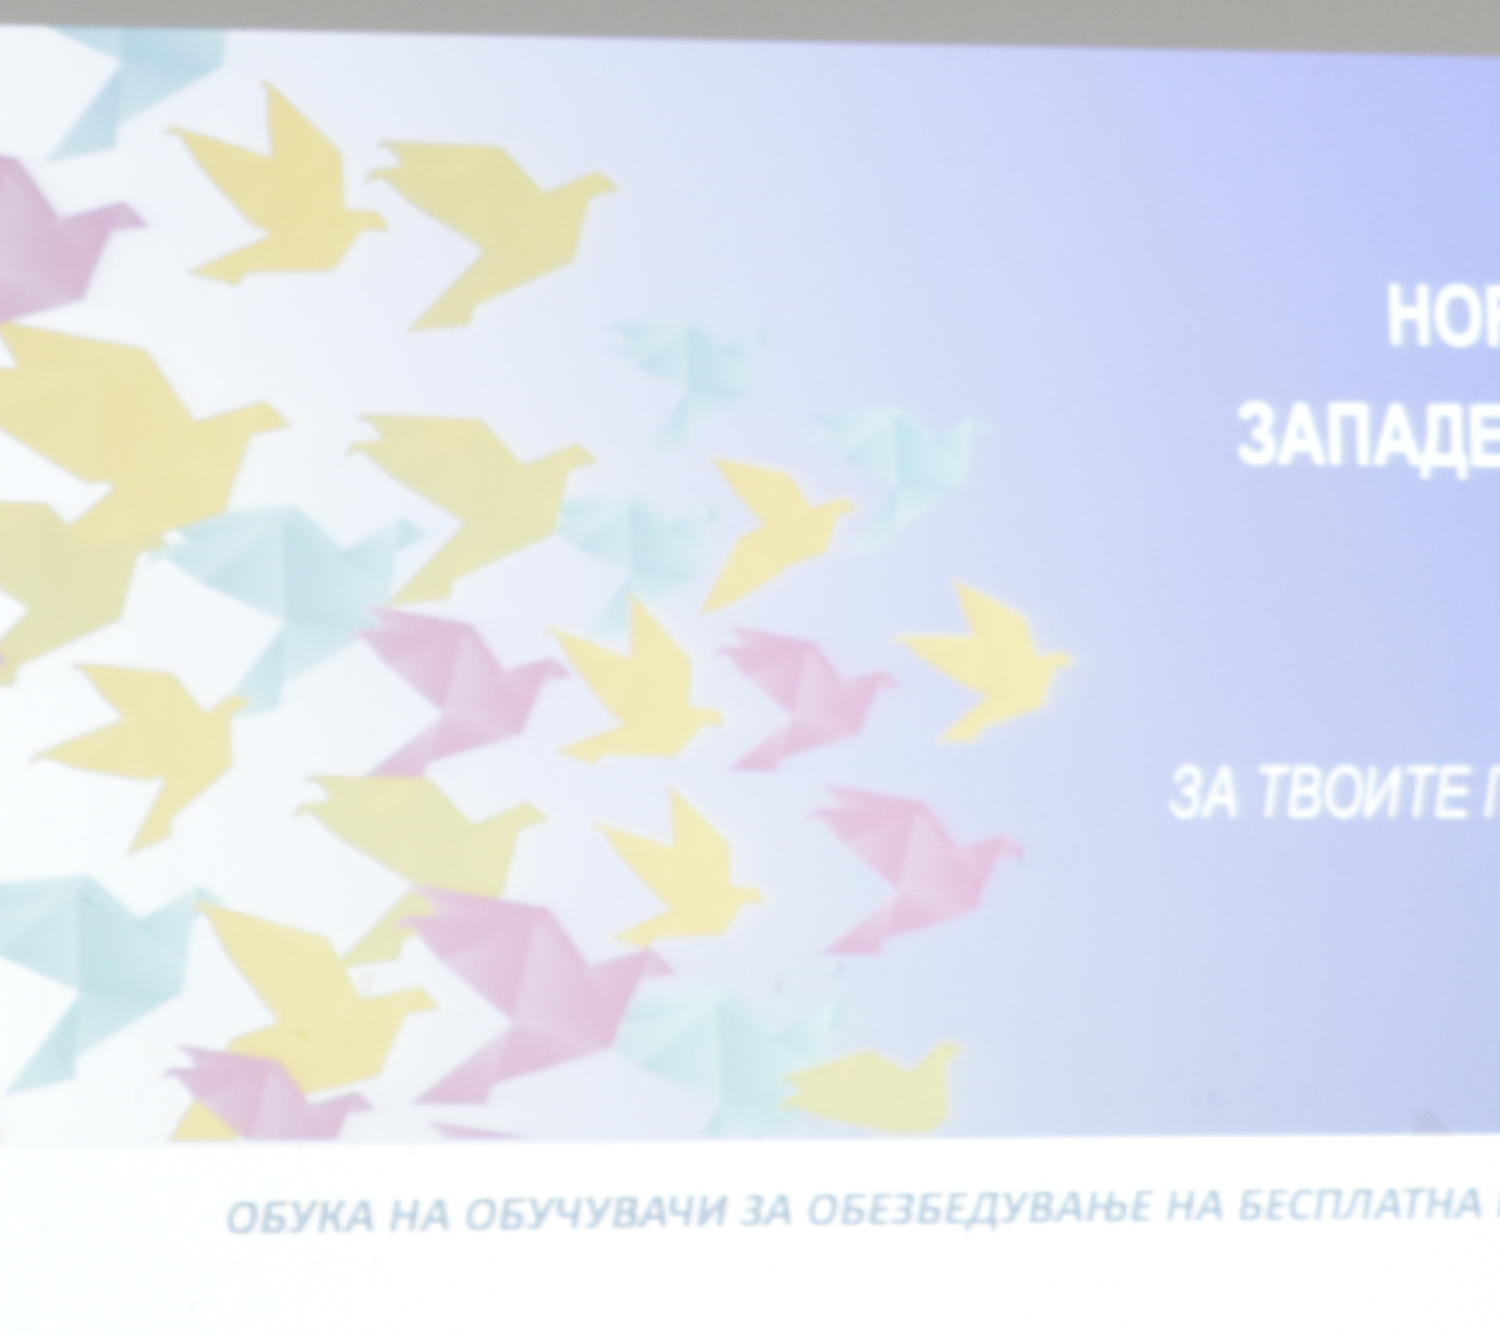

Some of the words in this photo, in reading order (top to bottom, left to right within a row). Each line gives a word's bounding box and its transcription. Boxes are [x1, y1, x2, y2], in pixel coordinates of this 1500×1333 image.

[1168, 764, 1239, 821] ЗА
[1259, 764, 1473, 821] ТВОИТЕ
[226, 1198, 376, 1236] ОБУКА
[388, 1197, 451, 1233] НА
[464, 1194, 731, 1233] ОБУЧУВАЧИ
[740, 1193, 793, 1229] ЗА
[806, 1189, 1154, 1232] ОБЕЗБЕДУВАЊЕ
[1166, 1188, 1225, 1223] НА
[1237, 1185, 1483, 1222] БЕСПЛАТНА
